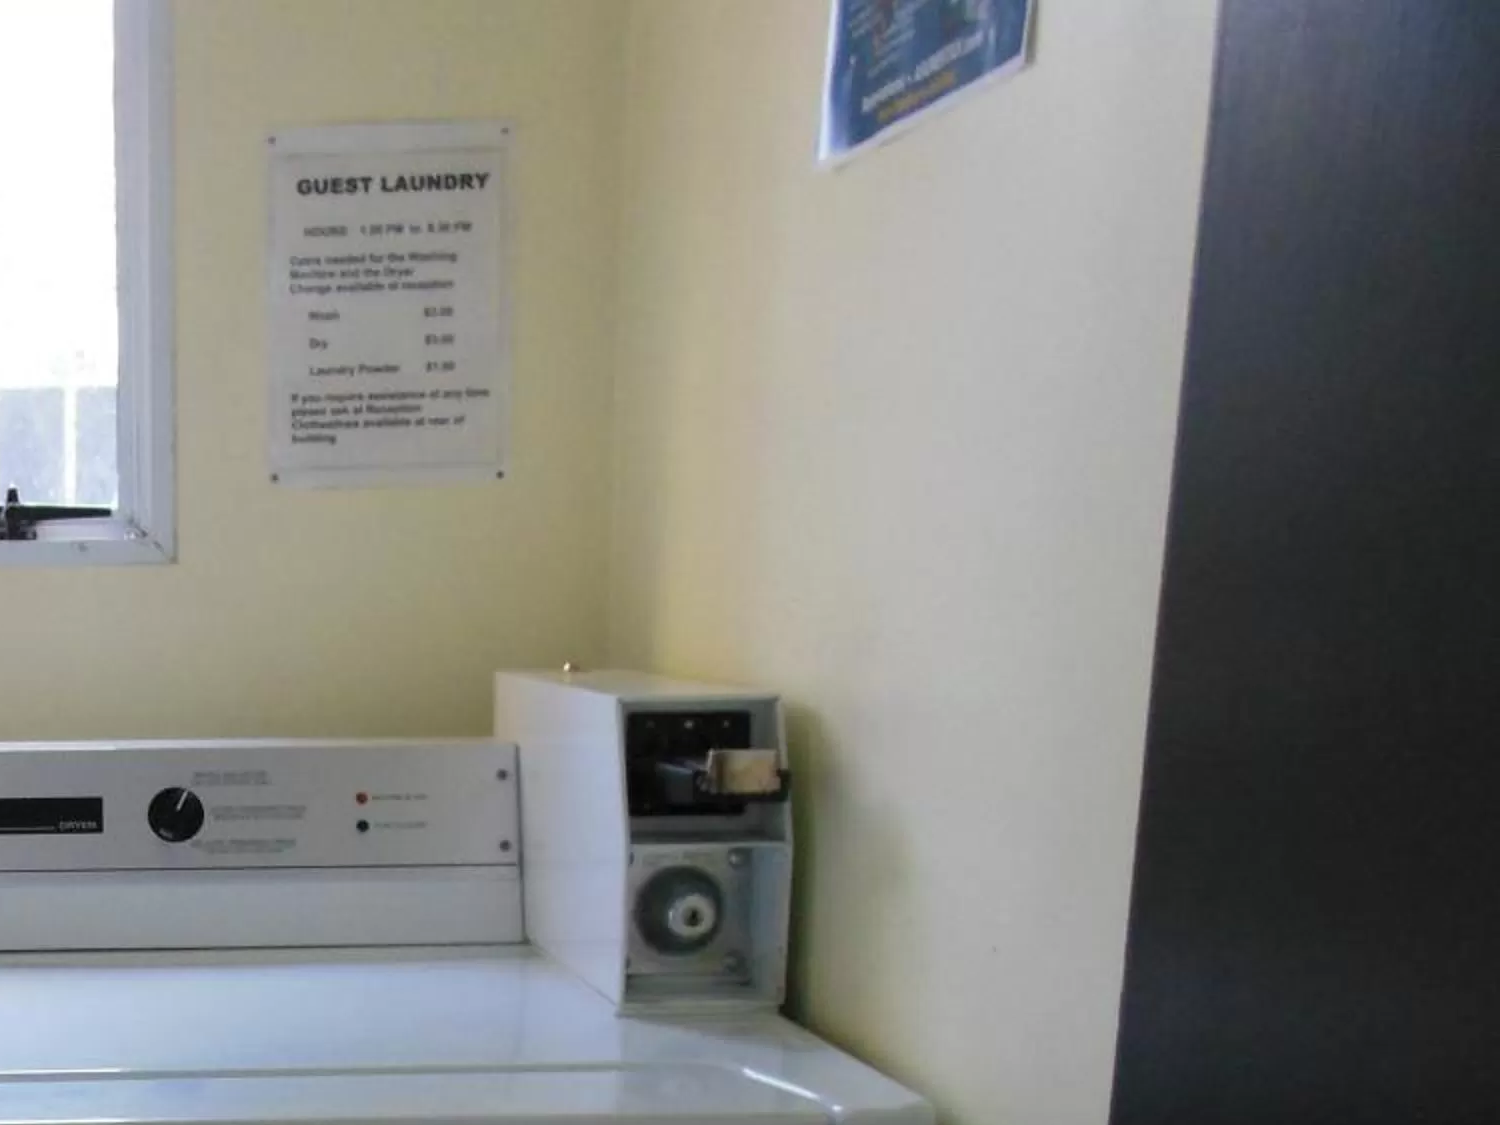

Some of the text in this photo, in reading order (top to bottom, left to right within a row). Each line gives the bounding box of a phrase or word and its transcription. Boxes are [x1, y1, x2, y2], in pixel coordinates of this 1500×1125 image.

[297, 173, 490, 195] GUEST LAUNDRY
[384, 267, 413, 278] Dryer
[290, 284, 331, 294] Change
[309, 337, 328, 351] Dry
[309, 365, 355, 377] Laundry
[358, 364, 400, 374] Powder
